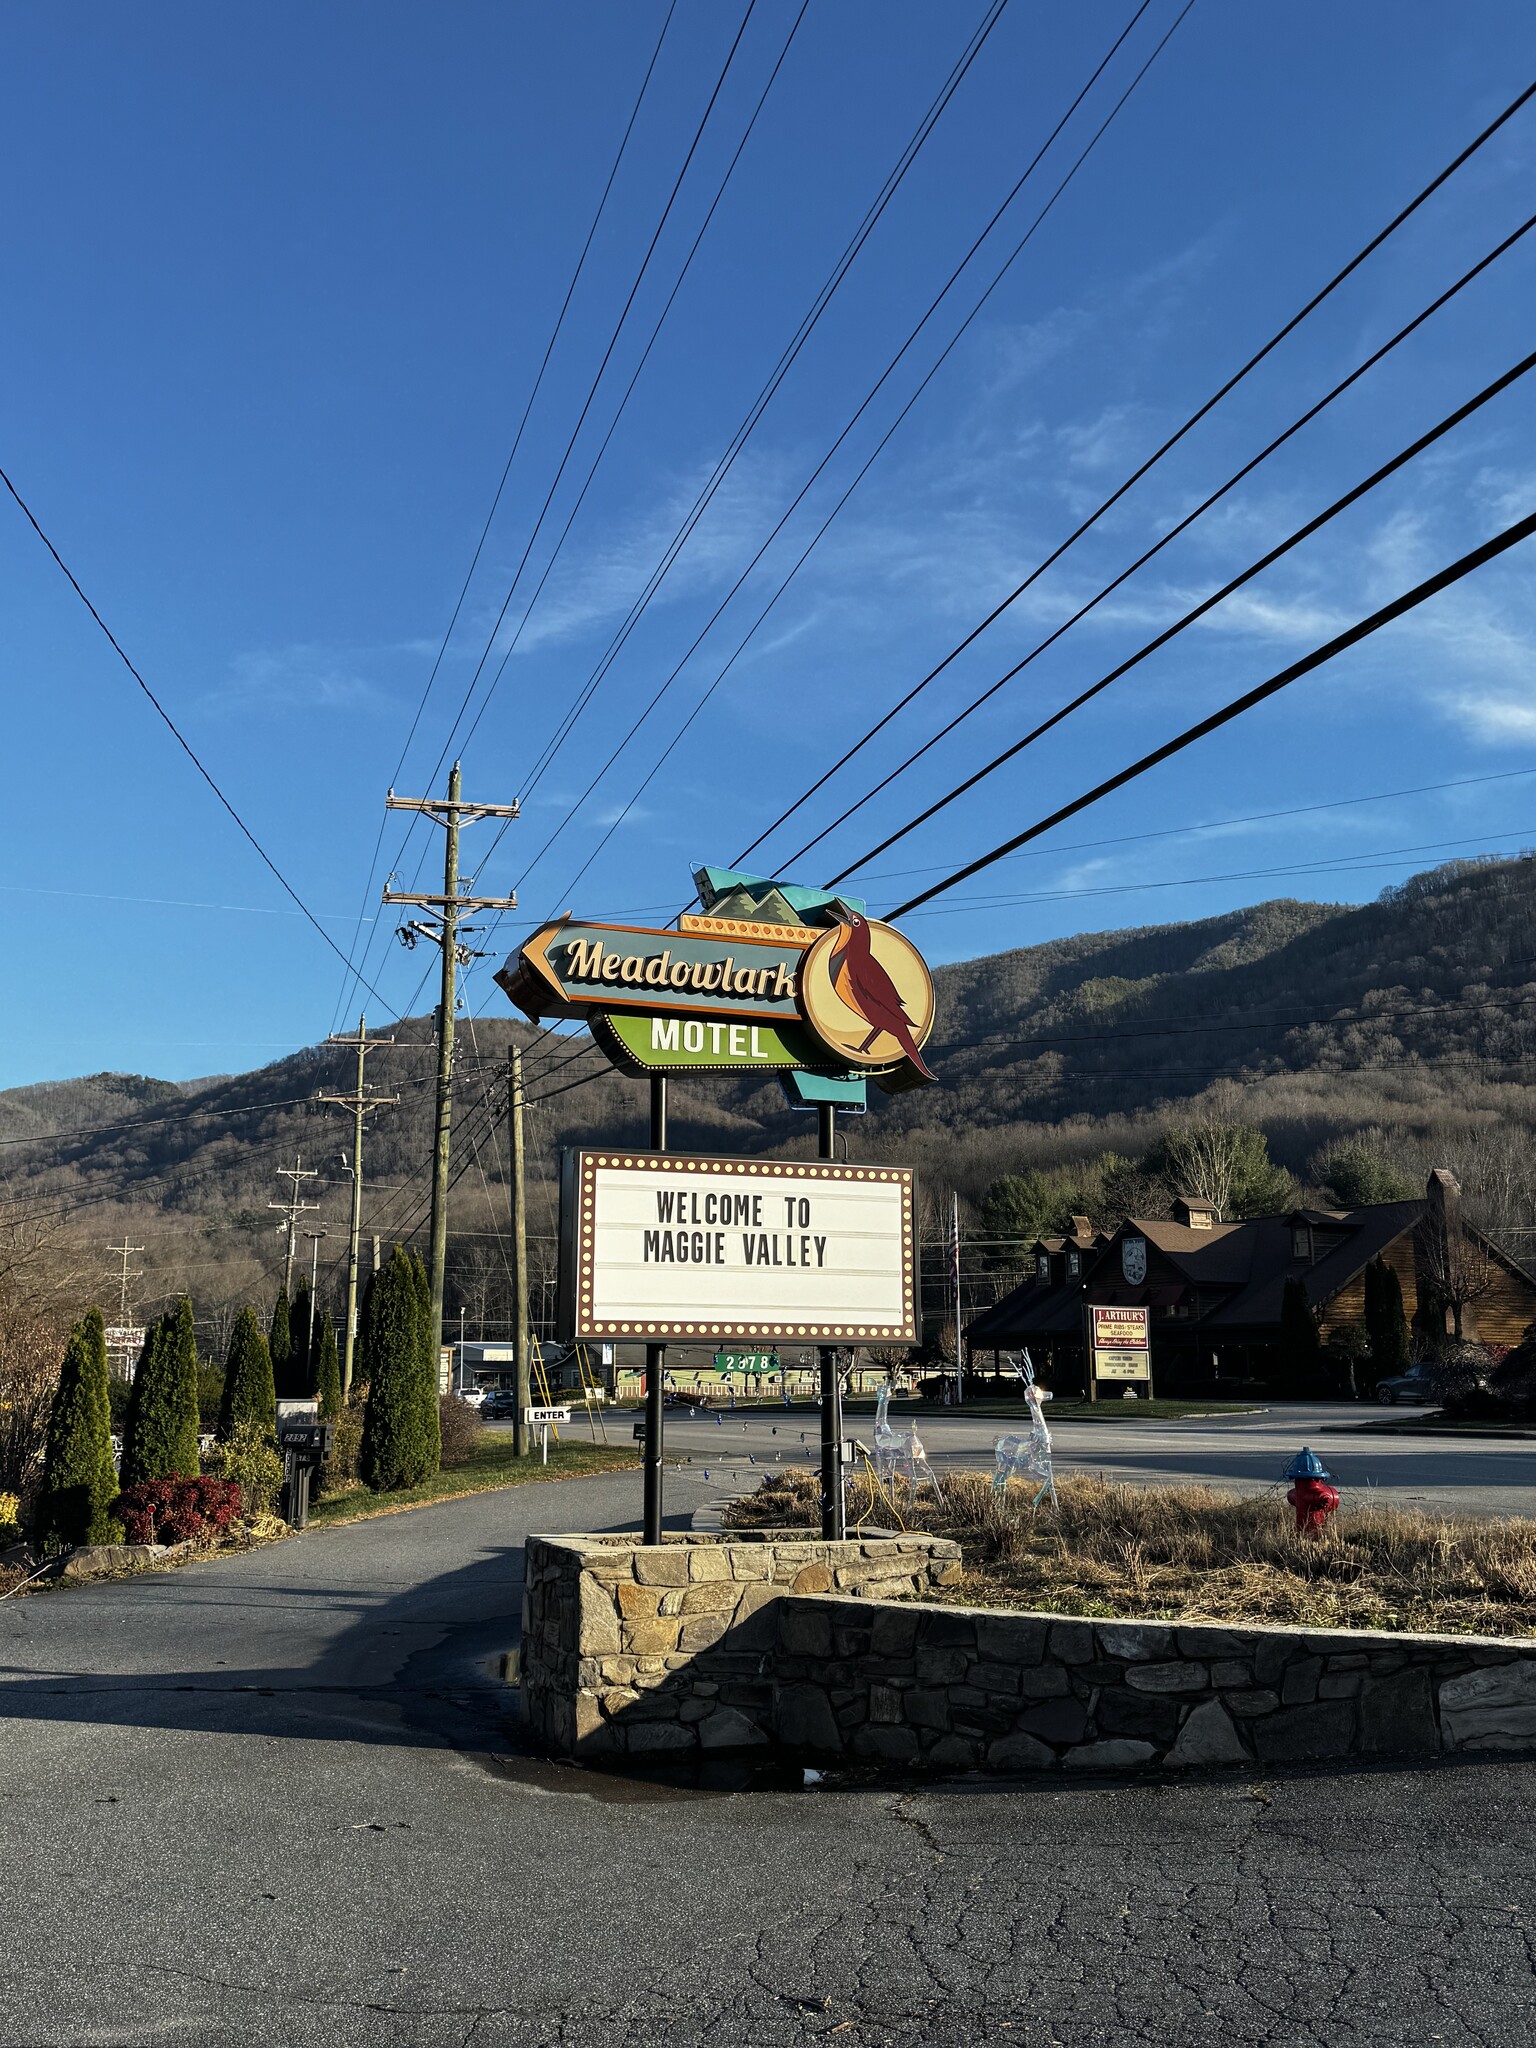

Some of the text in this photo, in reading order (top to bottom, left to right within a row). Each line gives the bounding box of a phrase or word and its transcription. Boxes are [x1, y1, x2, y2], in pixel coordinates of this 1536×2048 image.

[566, 938, 798, 999] Meadowlark
[651, 1017, 769, 1059] MOTEL
[656, 1190, 810, 1229] WELCOME TO
[643, 1230, 827, 1268] MAGGIE VALLEY
[1106, 1311, 1144, 1321] ARTHUR'S
[533, 1410, 565, 1420] ENTER
